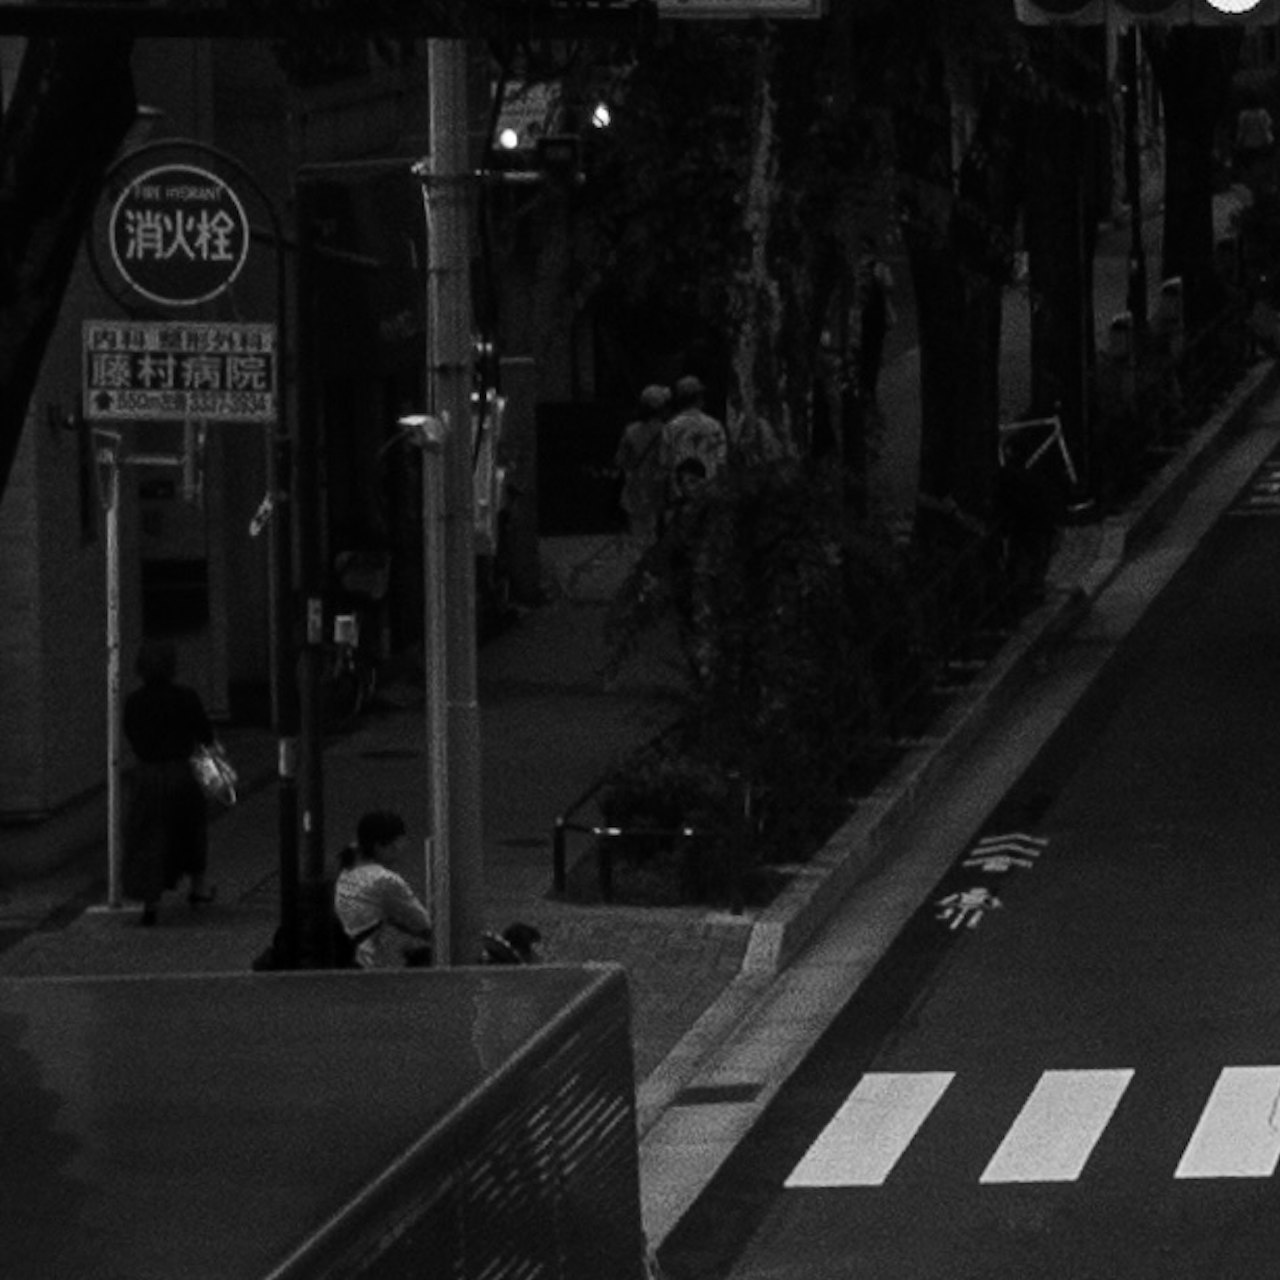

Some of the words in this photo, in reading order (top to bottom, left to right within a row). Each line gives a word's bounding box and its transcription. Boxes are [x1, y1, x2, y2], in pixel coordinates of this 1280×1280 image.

[125, 209, 235, 261] 消火栓
[91, 353, 268, 389] 藤村病院
